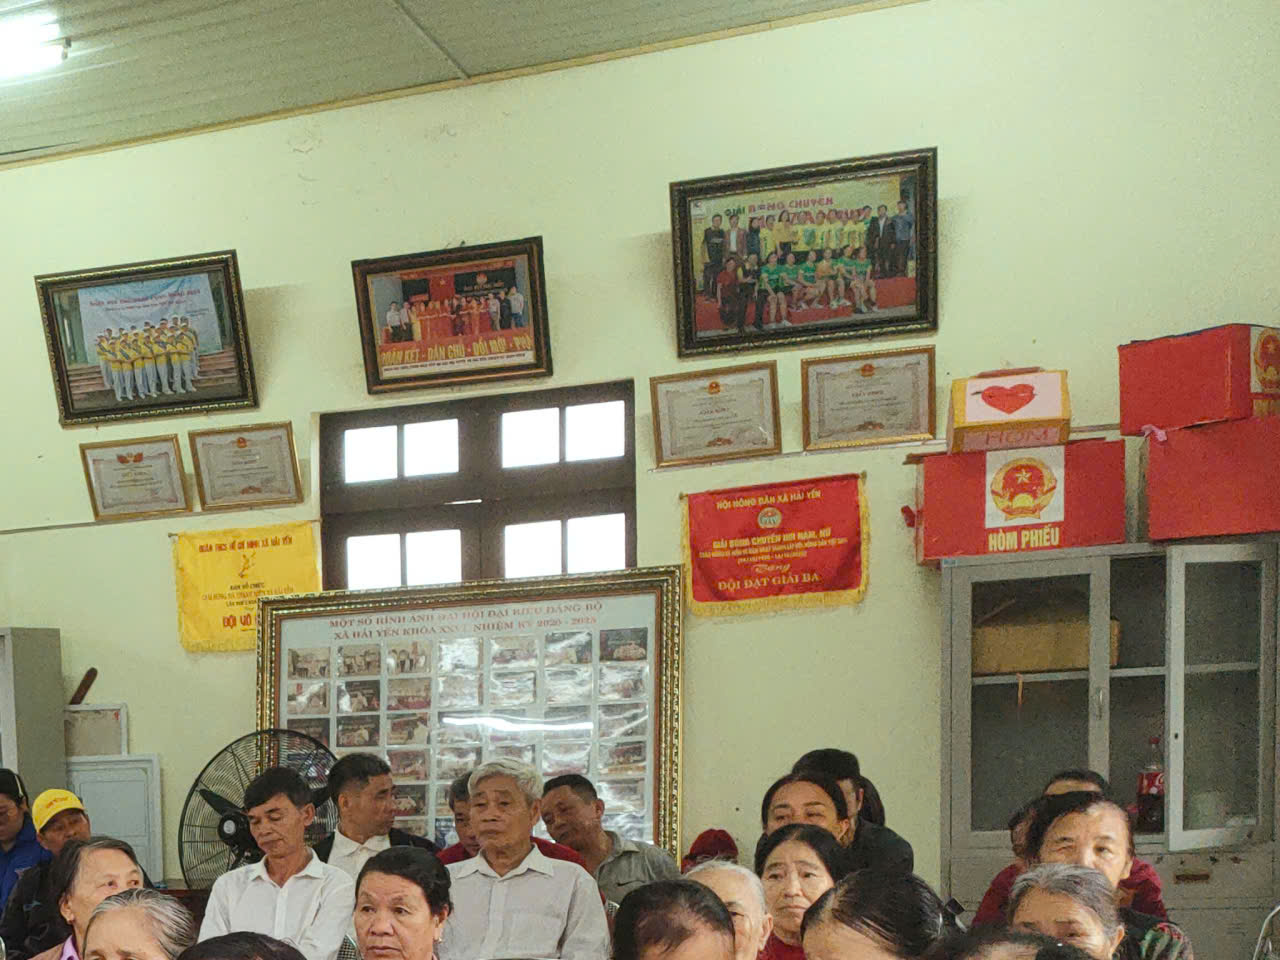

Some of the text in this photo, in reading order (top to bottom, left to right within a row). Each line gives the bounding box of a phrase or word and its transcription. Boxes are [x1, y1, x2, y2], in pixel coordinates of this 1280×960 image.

[988, 524, 1060, 551] HÒM PHIẾU
[718, 578, 740, 593] ĐỘI
[744, 577, 770, 590] ĐẠT
[329, 618, 354, 629] MỘT
